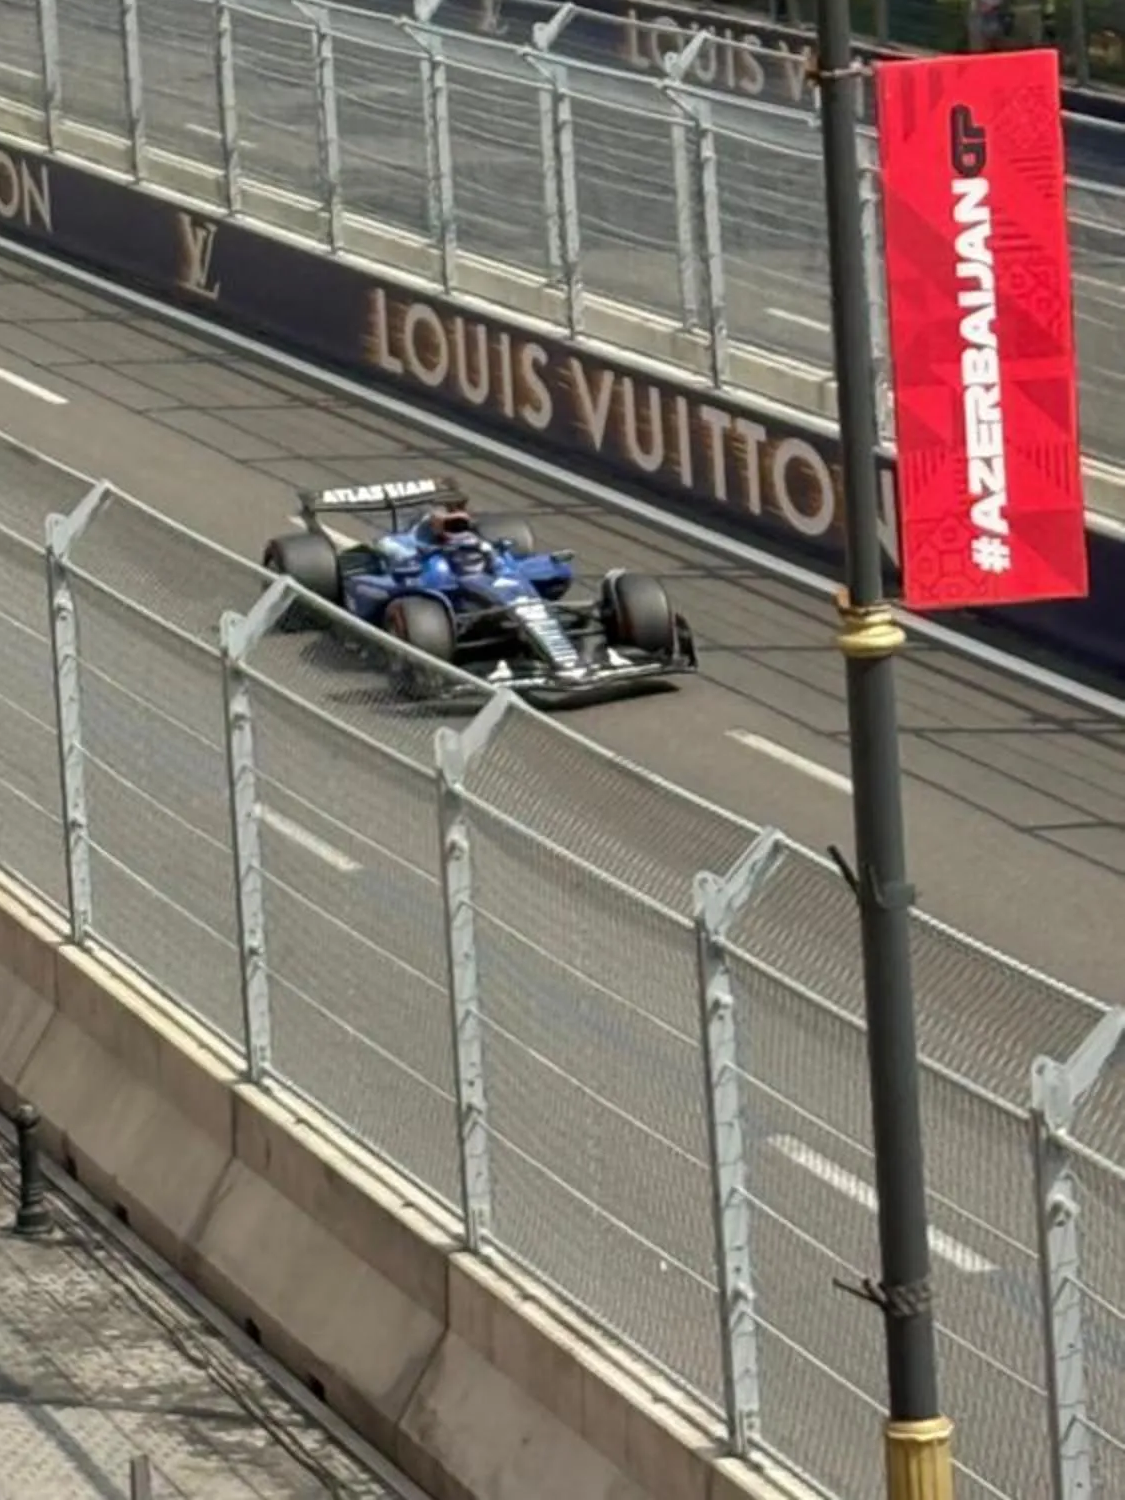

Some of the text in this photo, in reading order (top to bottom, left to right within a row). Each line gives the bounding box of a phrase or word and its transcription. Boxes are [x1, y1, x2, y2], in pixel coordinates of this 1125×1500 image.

[628, 8, 765, 95] LOUIS
[374, 287, 553, 430] LOUIS
[322, 479, 436, 503] ATLASSIAN
